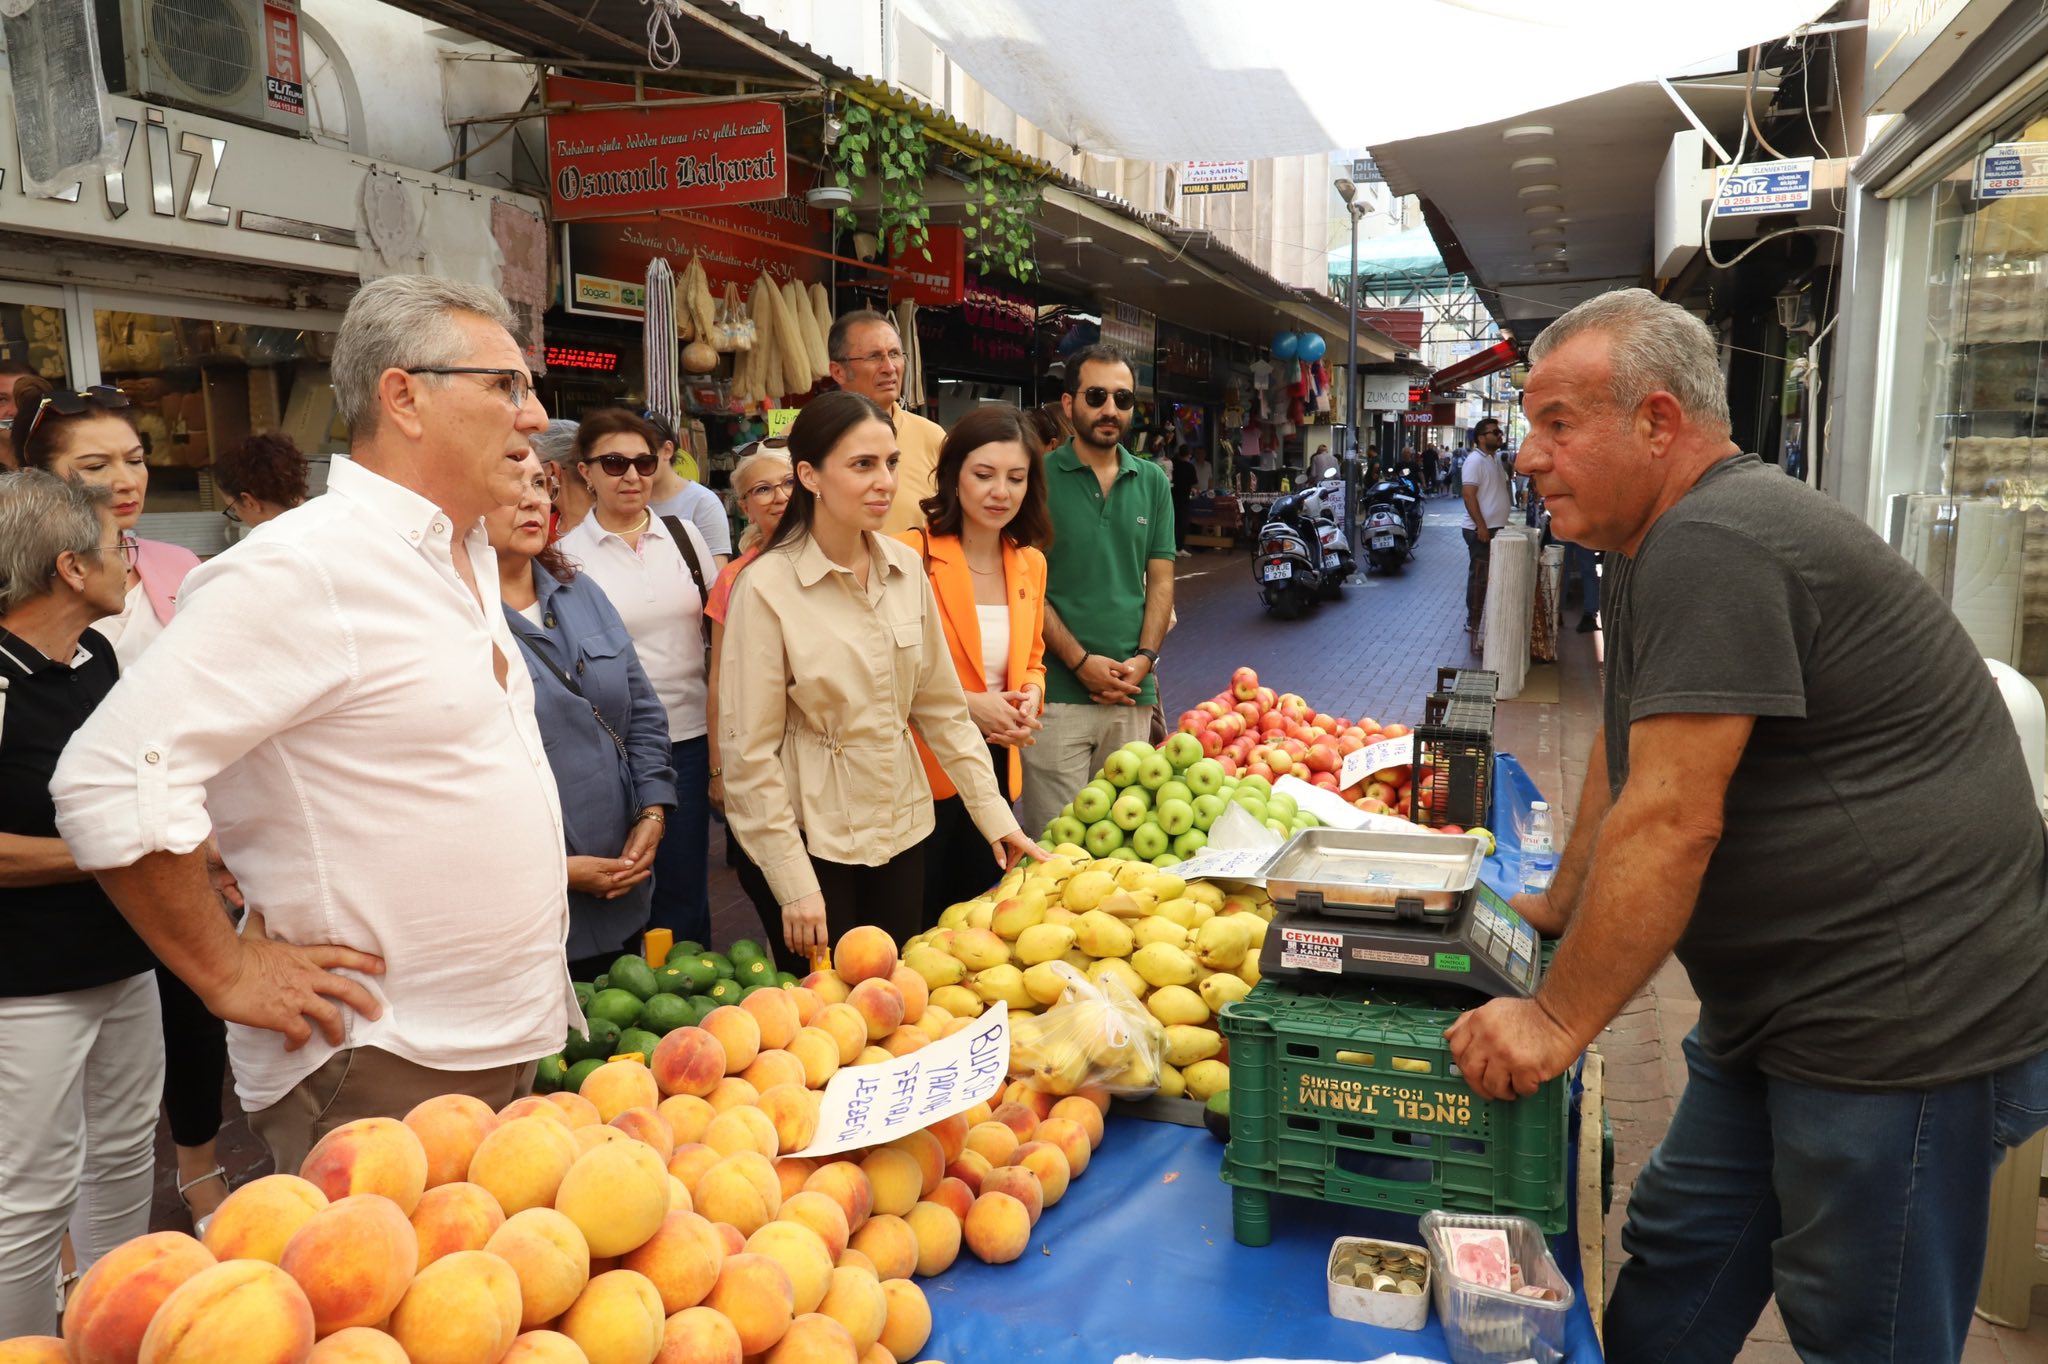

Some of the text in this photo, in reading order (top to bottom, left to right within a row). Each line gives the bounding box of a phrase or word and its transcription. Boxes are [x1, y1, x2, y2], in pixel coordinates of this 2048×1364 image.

[627, 133, 657, 149] dededen
[661, 134, 688, 145] toruna
[693, 129, 710, 141] 150
[740, 118, 771, 136] tecrübe
[557, 148, 777, 200] Osmanlı Baharat
[1183, 182, 1246, 193] KUMAŞ BULUNUR
[1733, 197, 1751, 205] 256
[1754, 195, 1772, 204] 315
[1790, 192, 1803, 201] 55
[1286, 931, 1339, 946] CEYHAN
[1301, 949, 1339, 959] KANTAR
[961, 1023, 1003, 1100] BURSA
[1434, 1091, 1470, 1106] HAL
[1299, 1087, 1471, 1126] ÖNCEL TARIM
